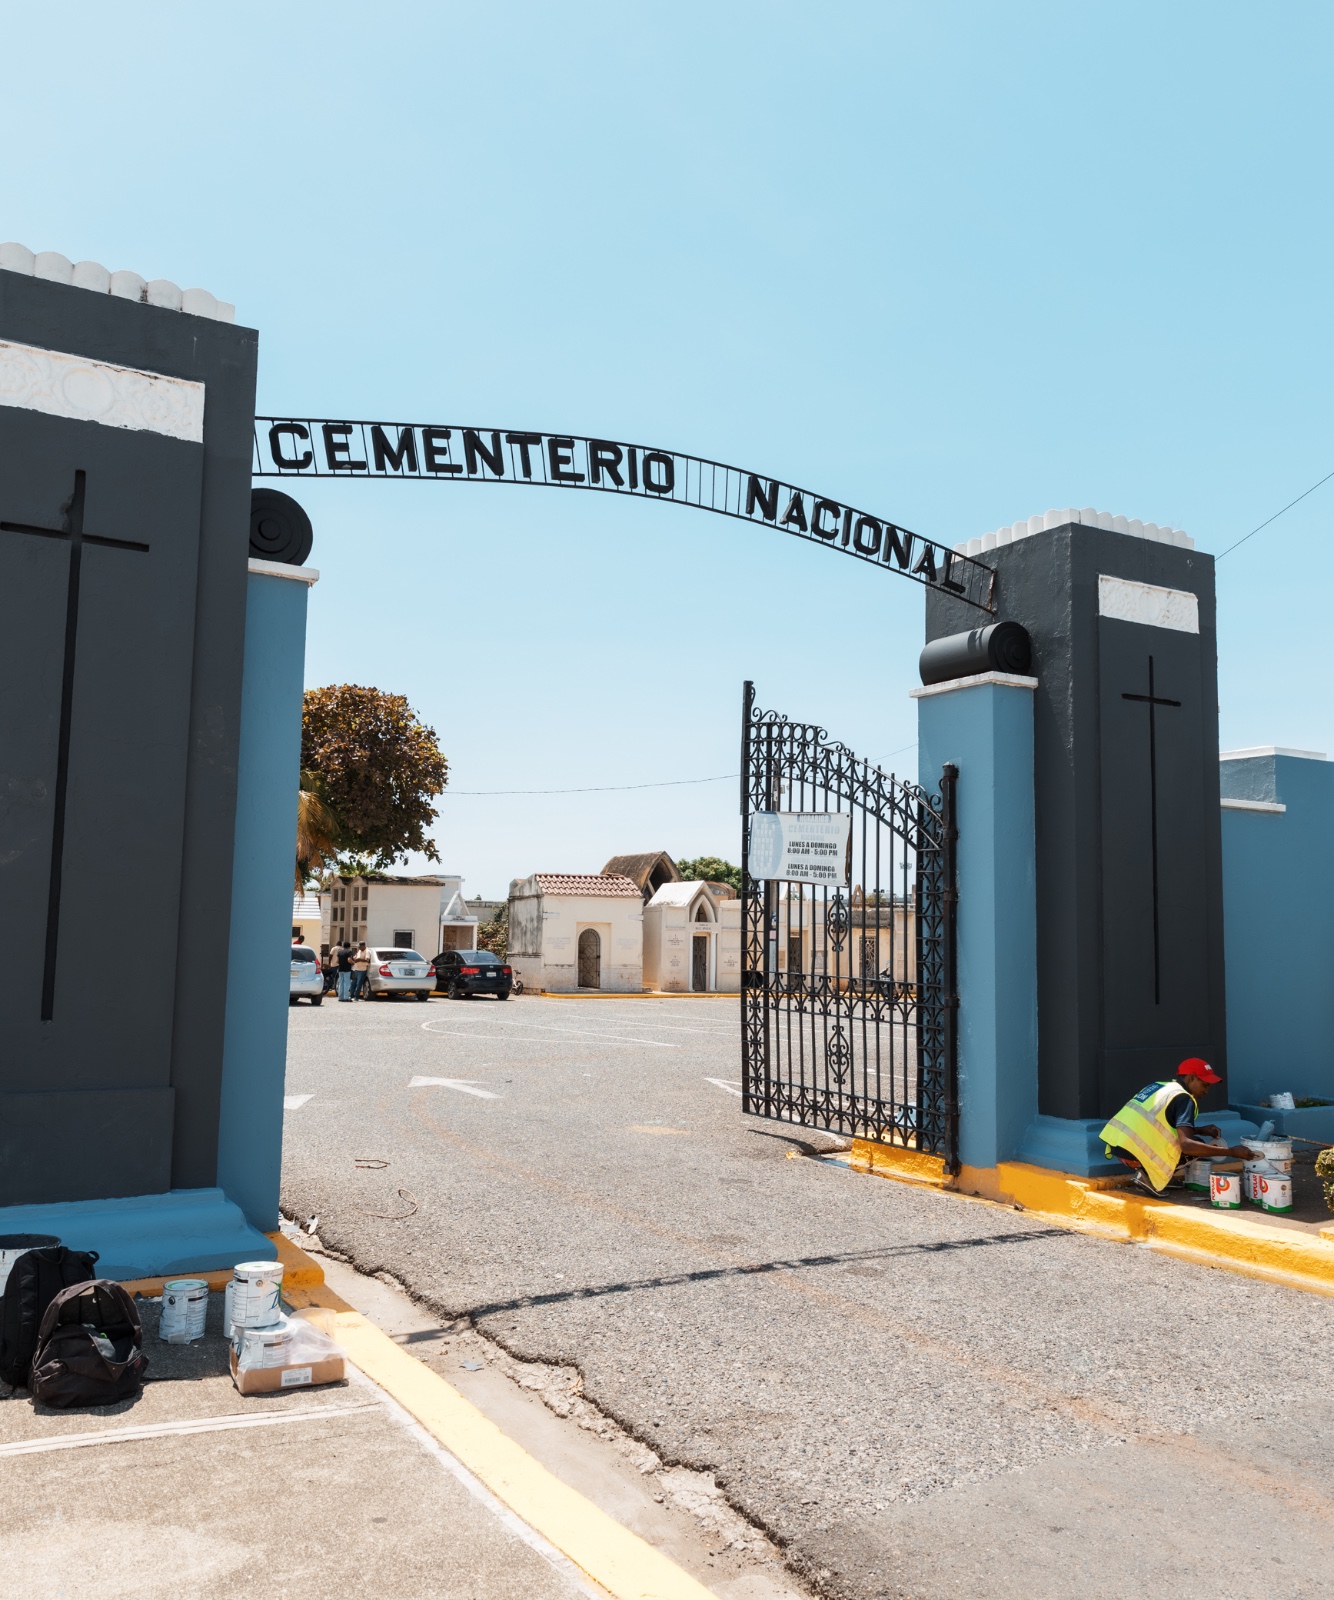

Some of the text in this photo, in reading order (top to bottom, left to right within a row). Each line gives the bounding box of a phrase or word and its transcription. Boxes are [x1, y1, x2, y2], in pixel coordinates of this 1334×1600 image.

[268, 422, 966, 594] CEMENTERIO NACIONAL
[788, 824, 840, 834] CEMENTERIO
